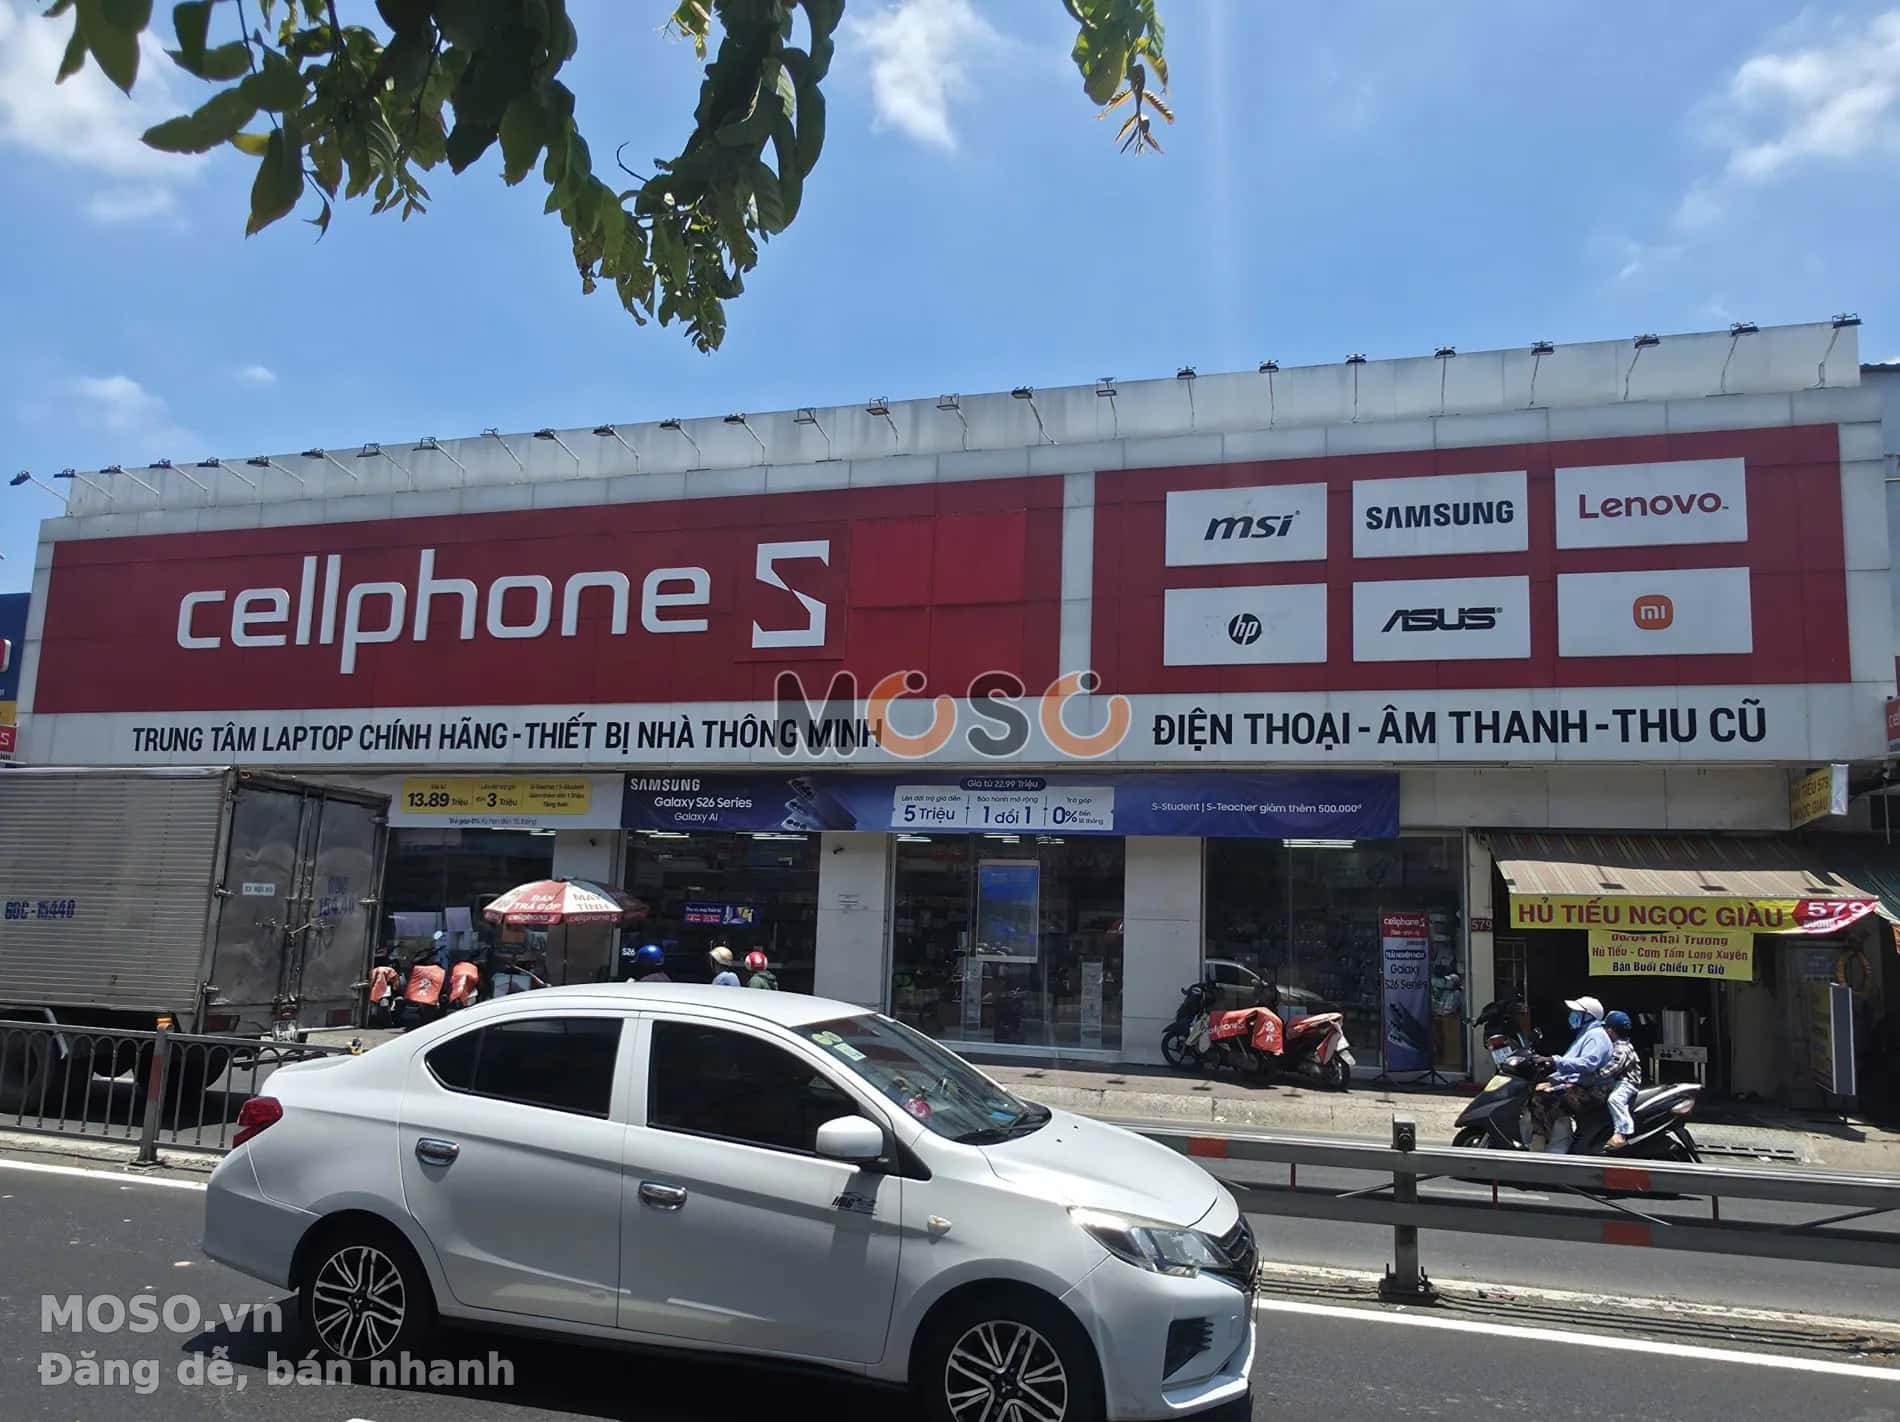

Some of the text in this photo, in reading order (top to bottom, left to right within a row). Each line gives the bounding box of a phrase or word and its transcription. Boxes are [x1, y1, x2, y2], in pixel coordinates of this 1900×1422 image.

[1579, 491, 1725, 519] Lenovo
[1366, 500, 1514, 529] SAMSUNG
[1204, 514, 1293, 540] msi
[177, 549, 711, 674] cellphone
[1381, 607, 1499, 633] ASUS
[1230, 614, 1261, 645] hp
[133, 726, 204, 752] TRUNG
[211, 721, 257, 752] TÂM
[262, 725, 354, 751] LAPTOP
[359, 718, 431, 751] CHÍNH
[439, 717, 508, 750] HÃNG
[525, 712, 597, 750] THIẾT
[604, 722, 629, 754] BỊ
[637, 715, 695, 749] NHÀ
[702, 713, 798, 748] THÔNG
[807, 719, 883, 748] MINH
[1152, 706, 1233, 752] ĐIỆN
[1243, 712, 1351, 751] THOẠI
[1376, 704, 1437, 744] ÂM
[1448, 710, 1588, 744] THANH
[1612, 708, 1697, 743] THU
[1709, 698, 1767, 743] CŨ
[630, 778, 701, 791] SAMSUNG
[994, 780, 1016, 788] 22.99
[1017, 779, 1039, 789] Triệu
[408, 792, 450, 807] 13.89
[487, 792, 497, 807] 3
[654, 796, 753, 810] Galaxy S26 Series
[674, 812, 709, 824] Galaxy
[904, 804, 955, 823] 5 Triệu
[983, 806, 990, 823] 1
[1025, 806, 1031, 823] 1
[1053, 806, 1078, 824] 0%
[1518, 896, 1554, 924] HỦ
[1629, 905, 1707, 930] NGỌC
[1715, 901, 1784, 928] GIÀU
[1807, 902, 1867, 919] 579
[1471, 919, 1493, 931] 579
[1688, 949, 1713, 960] Long
[1390, 964, 1419, 976] Galaxy
[1692, 963, 1703, 973] 17
